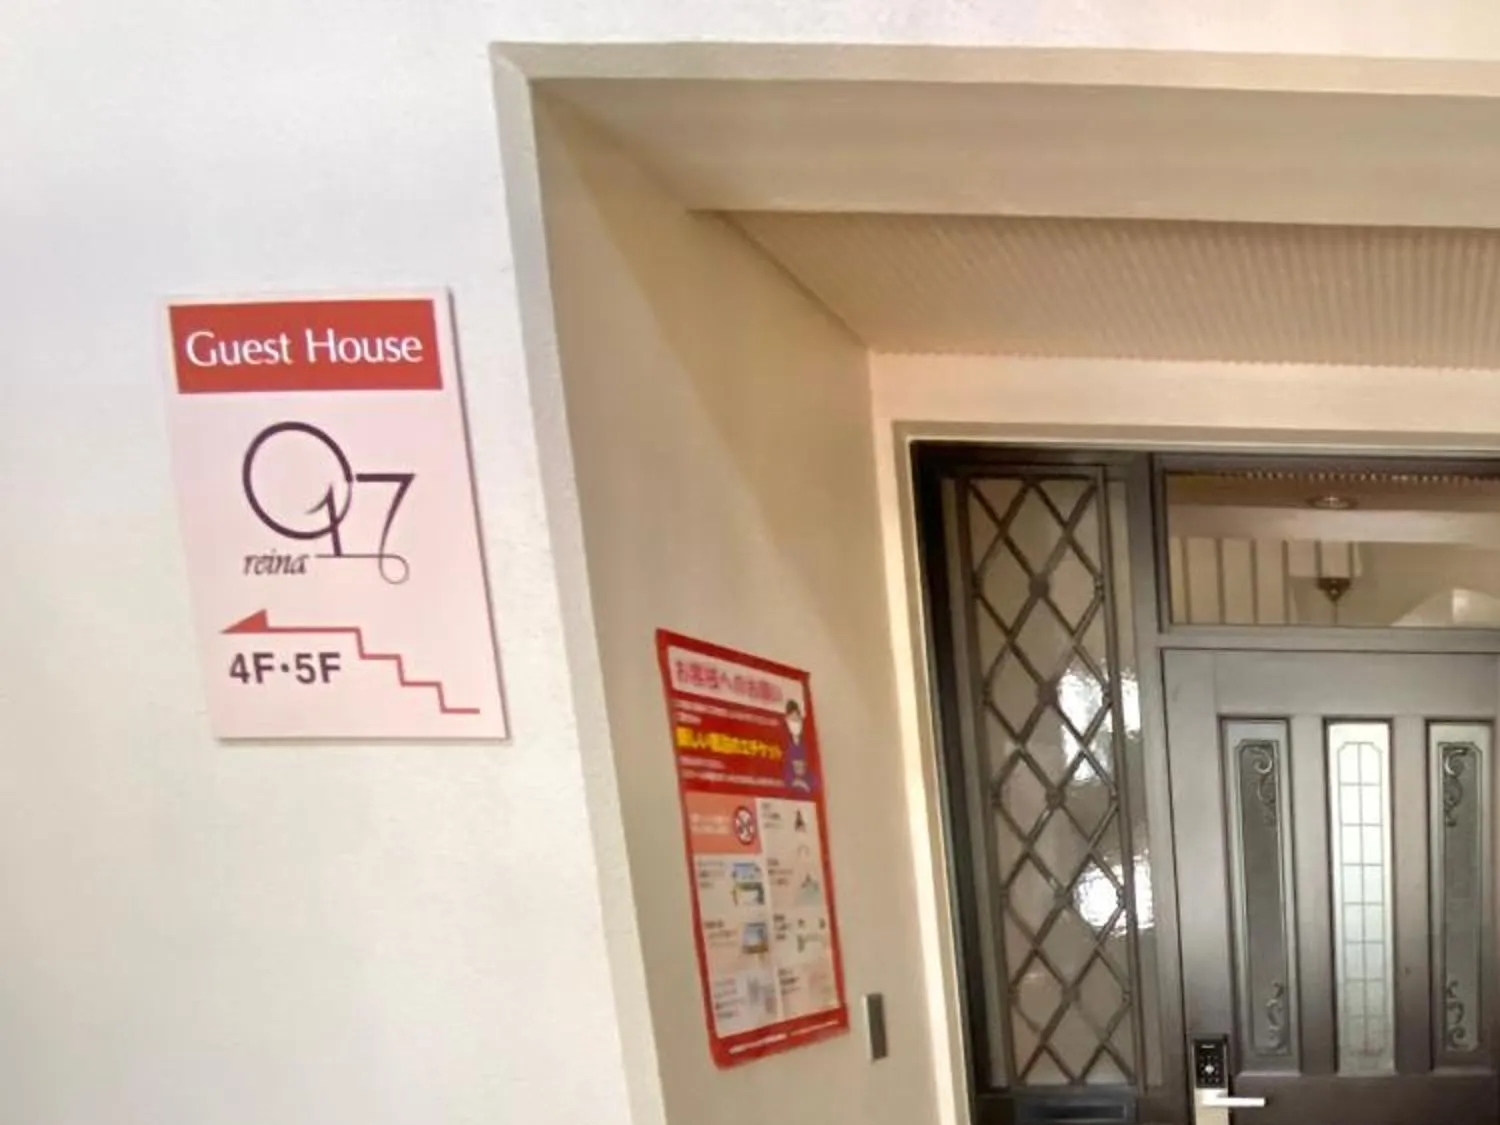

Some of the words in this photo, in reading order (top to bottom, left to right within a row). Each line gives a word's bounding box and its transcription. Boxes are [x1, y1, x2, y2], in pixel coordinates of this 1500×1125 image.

[186, 331, 292, 367] Guest
[305, 328, 424, 364] House
[242, 549, 309, 576] reina
